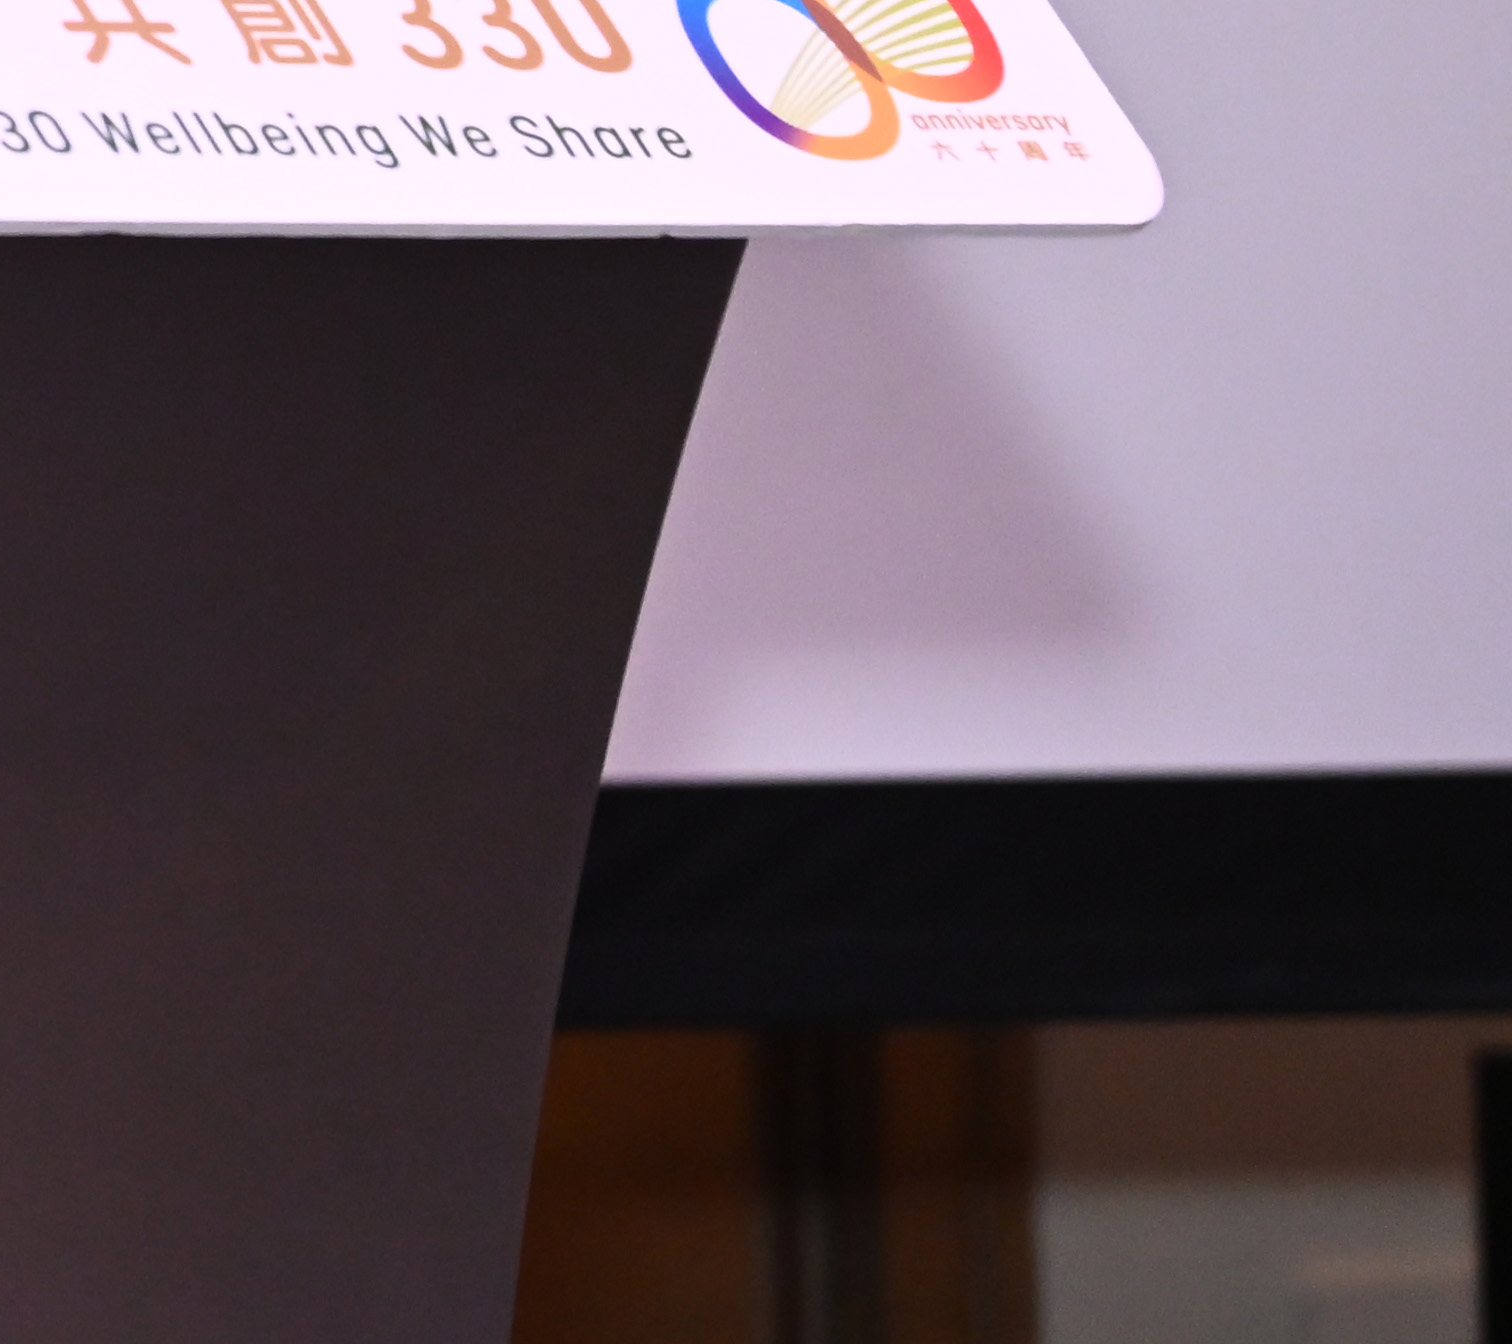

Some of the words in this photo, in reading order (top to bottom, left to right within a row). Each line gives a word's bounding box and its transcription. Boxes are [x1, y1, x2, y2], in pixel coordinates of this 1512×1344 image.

[80, 110, 400, 170] Wellbeing
[402, 114, 499, 160] We
[511, 114, 694, 160] Share
[910, 110, 1073, 139] anniversary
